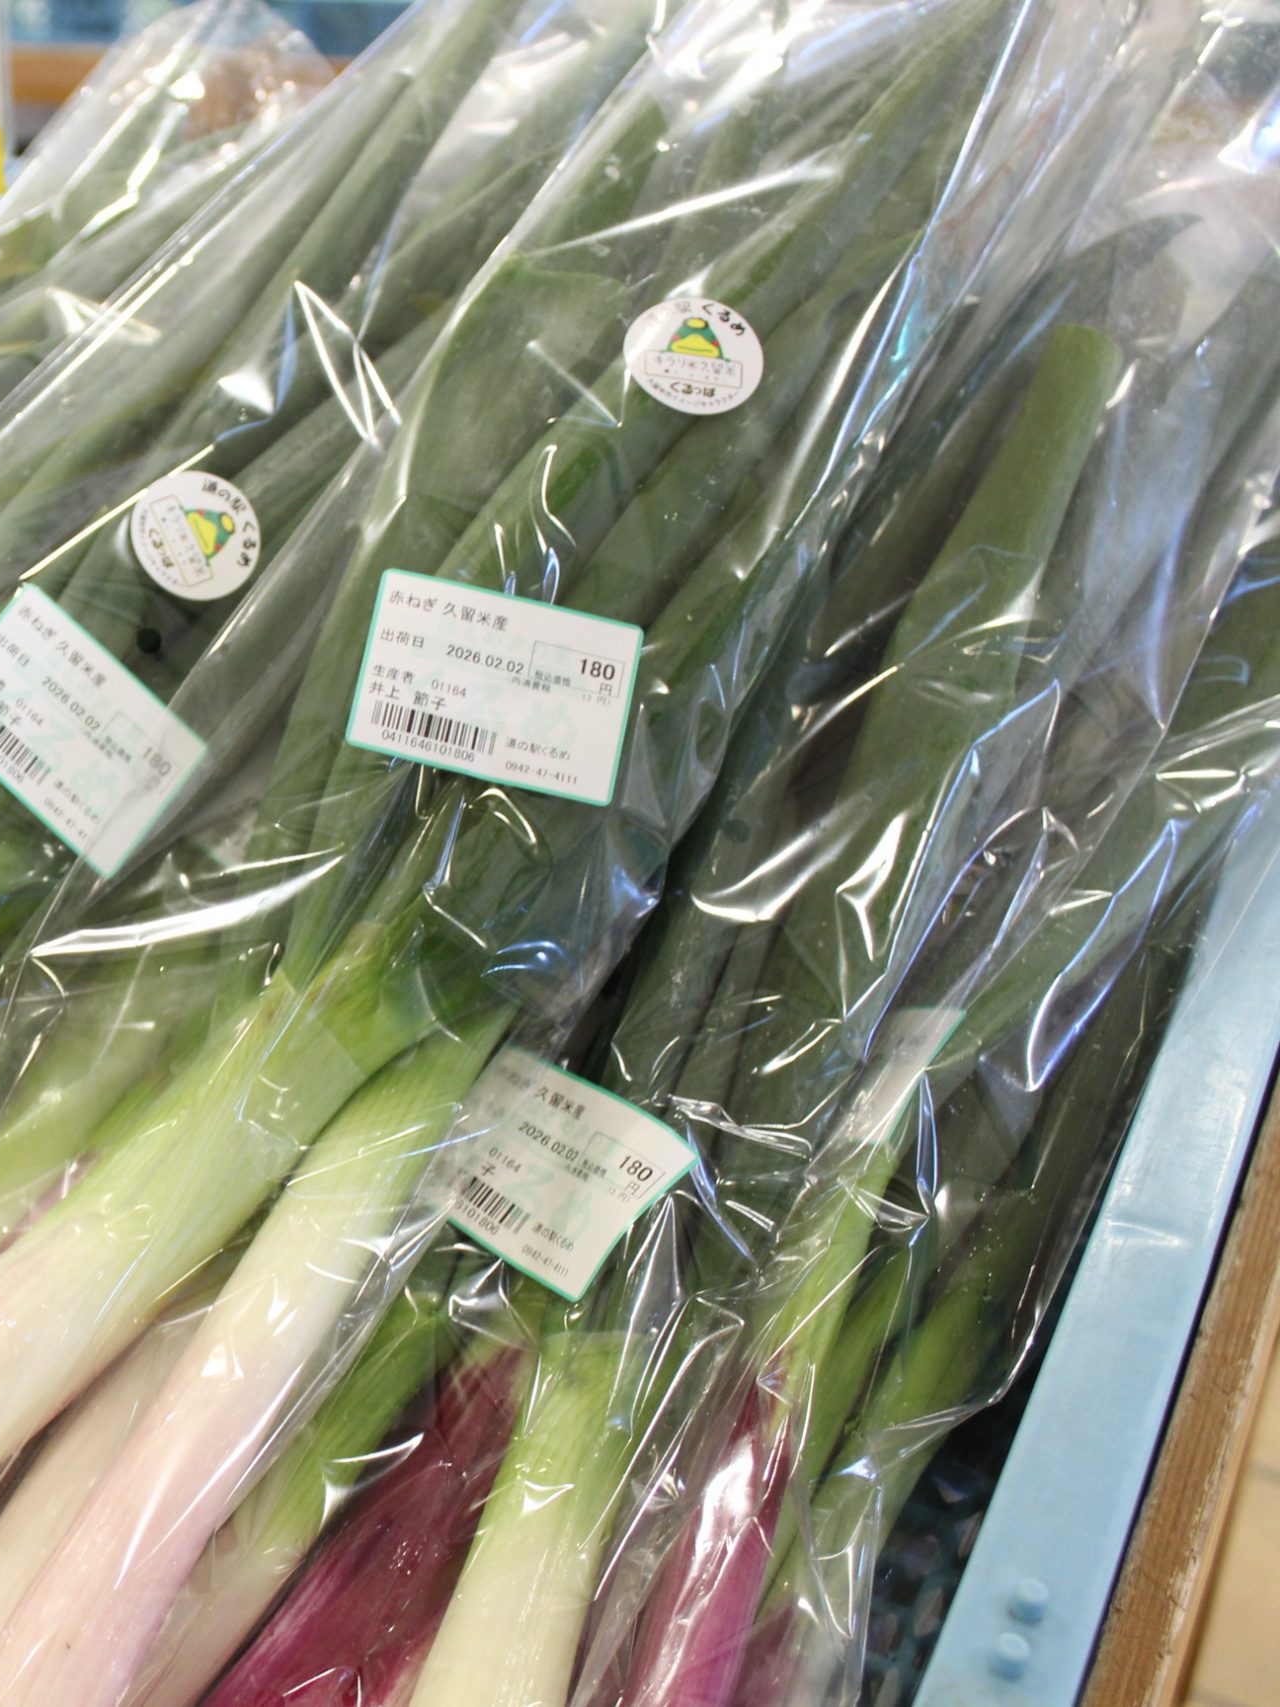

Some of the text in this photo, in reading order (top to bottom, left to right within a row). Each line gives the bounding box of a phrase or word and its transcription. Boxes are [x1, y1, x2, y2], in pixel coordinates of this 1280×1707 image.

[389, 589, 508, 631] 赤ねぎ 久留米産
[17, 606, 107, 689] 赤ねぎ 久留米産
[379, 628, 425, 649] 出荷日
[445, 643, 524, 674] 2026.02.02
[373, 664, 466, 698] 生産者 01164
[580, 657, 615, 681] 180
[41, 675, 101, 732] 2026.02.02
[368, 680, 400, 700] 井上
[14, 697, 44, 726] 01164
[141, 746, 172, 777] 180
[380, 730, 475, 763] 0411646101806
[534, 1085, 585, 1120] 久留米産
[517, 1120, 579, 1162] 2026.02.02
[487, 1145, 521, 1173] 01164
[618, 1155, 653, 1182] 180
